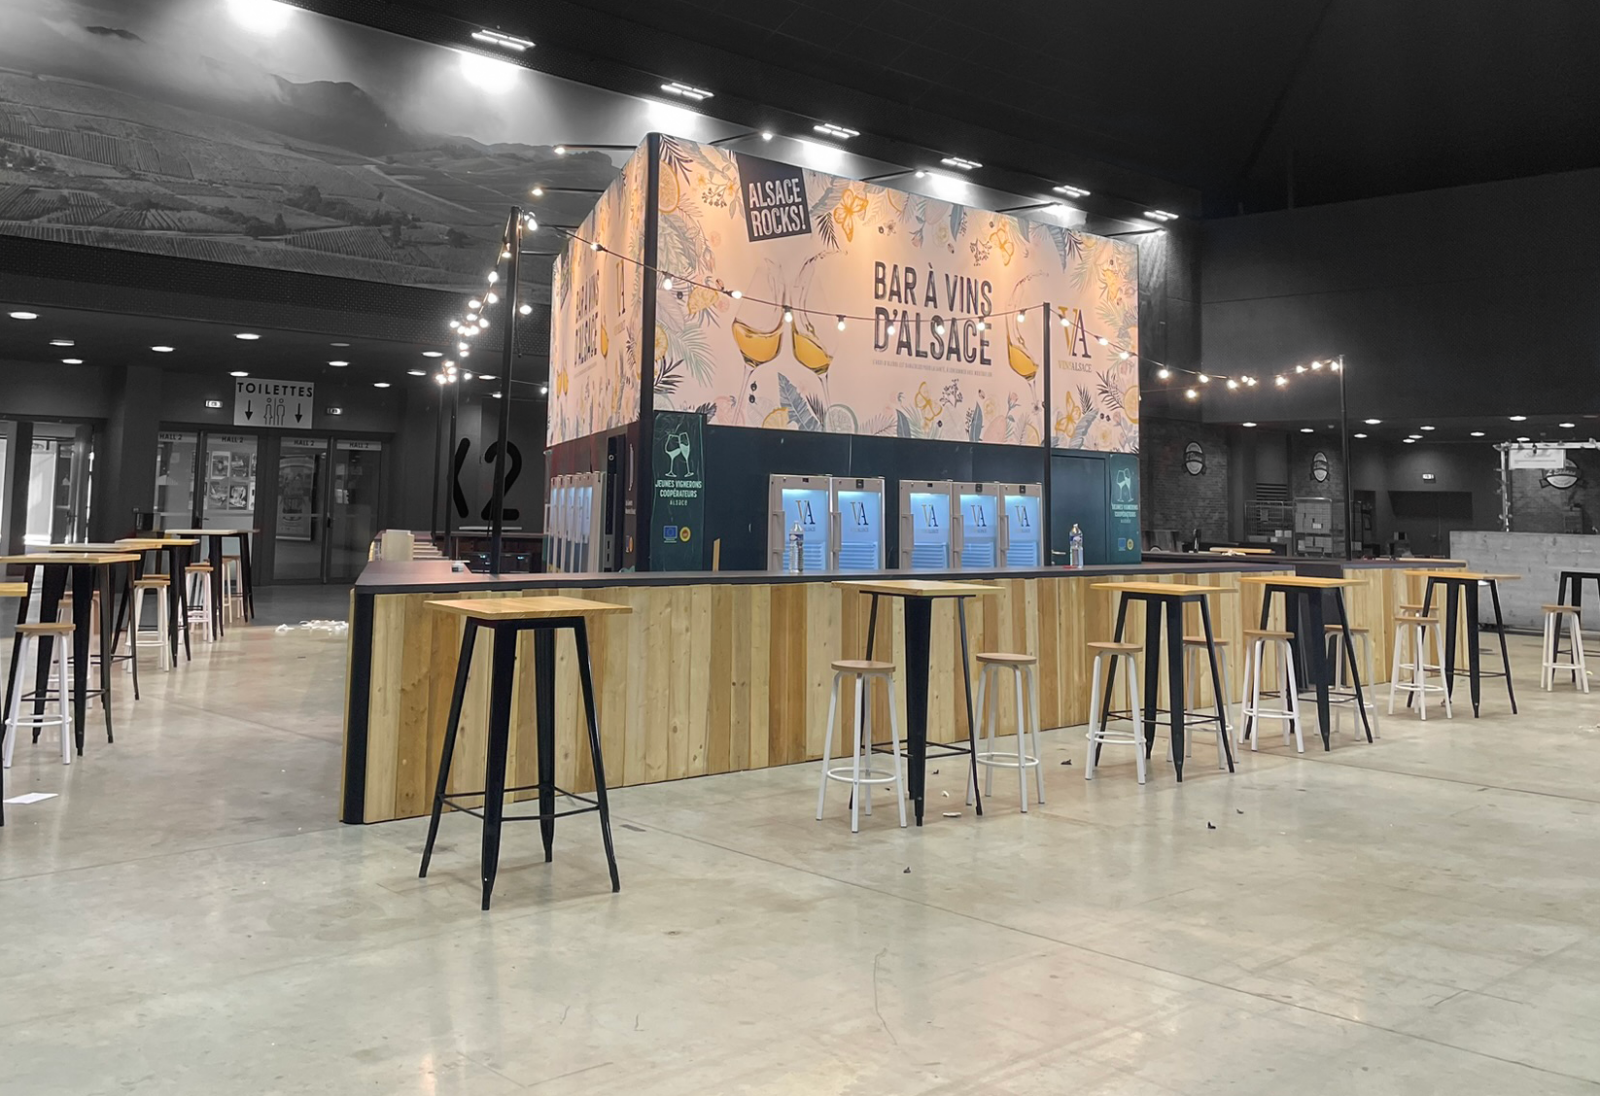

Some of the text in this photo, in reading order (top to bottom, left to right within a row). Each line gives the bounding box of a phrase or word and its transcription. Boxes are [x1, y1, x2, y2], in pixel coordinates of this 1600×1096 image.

[749, 178, 802, 208] ALSACE
[750, 205, 806, 237] ROCKS!
[874, 260, 992, 317] BAR À VINS
[874, 306, 992, 366] D'ALSACE
[1058, 306, 1092, 358] VA
[237, 382, 313, 398] TOILETTES
[159, 433, 176, 441] HALL
[221, 435, 237, 443] HALL
[655, 479, 702, 489] JEUNES VIGNERONS
[850, 501, 869, 526] VA
[921, 504, 939, 527] VA
[970, 504, 987, 527] VA
[1015, 505, 1031, 527] VA
